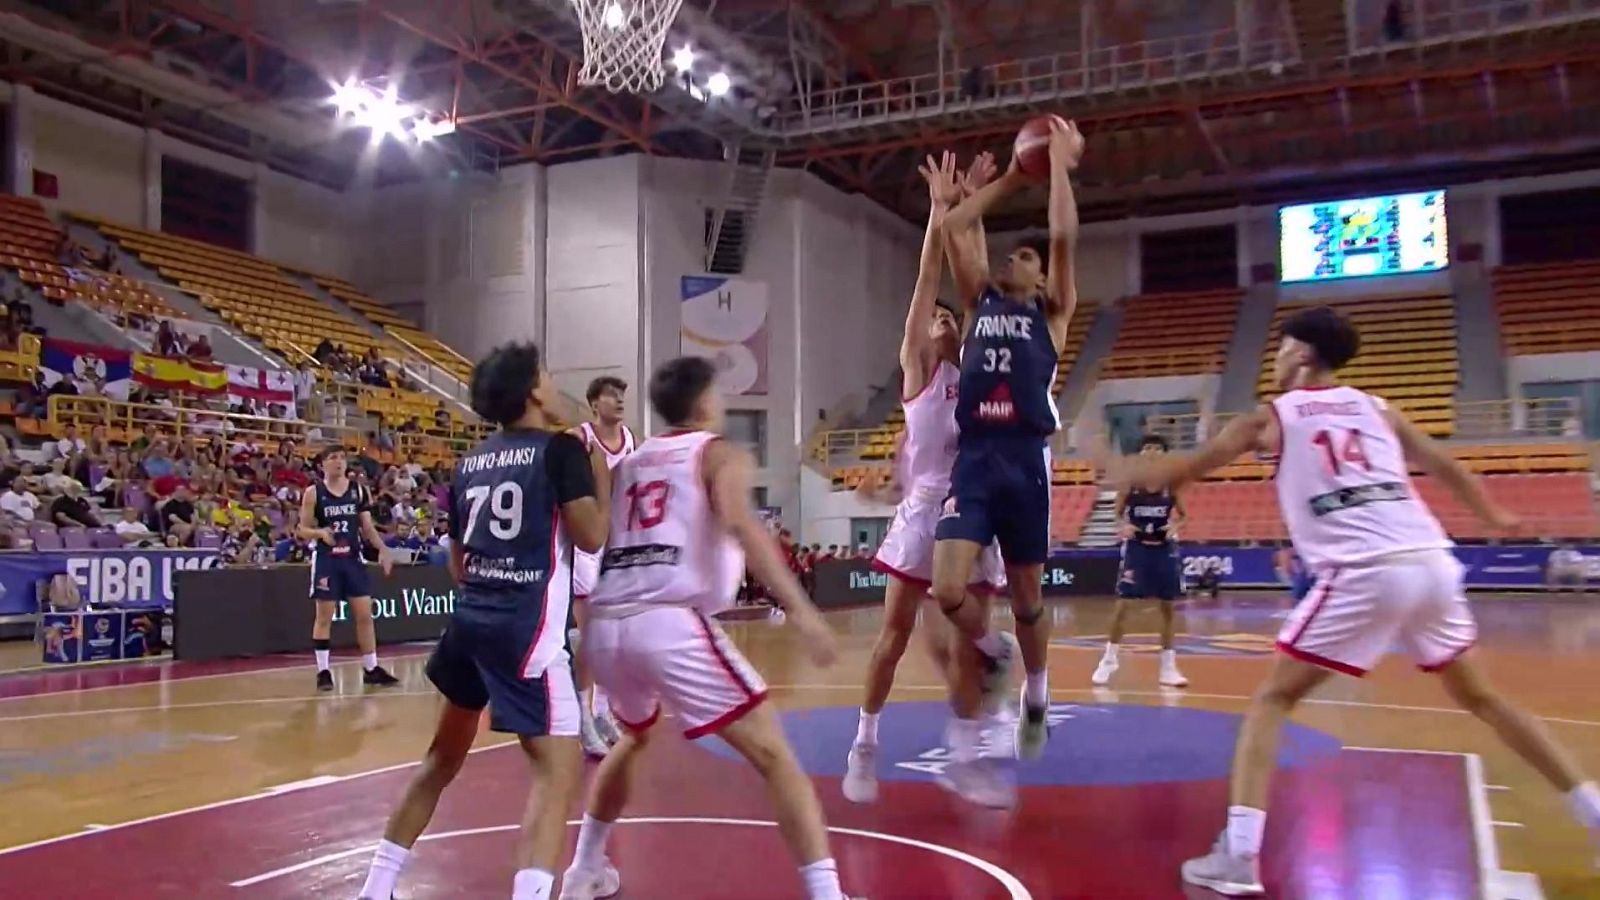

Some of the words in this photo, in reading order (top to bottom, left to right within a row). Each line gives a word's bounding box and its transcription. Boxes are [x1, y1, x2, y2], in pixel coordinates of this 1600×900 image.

[975, 315, 1033, 340] FRANCE
[983, 347, 1012, 373] 32
[462, 447, 536, 474] TOWO-NANSI
[1313, 428, 1372, 476] 14
[323, 503, 357, 517] FRANCE
[463, 480, 524, 545] 79
[625, 479, 671, 531] 13
[333, 520, 349, 533] 22
[66, 556, 151, 603] FIBA
[1052, 568, 1074, 586] Be
[402, 588, 456, 617] Want
